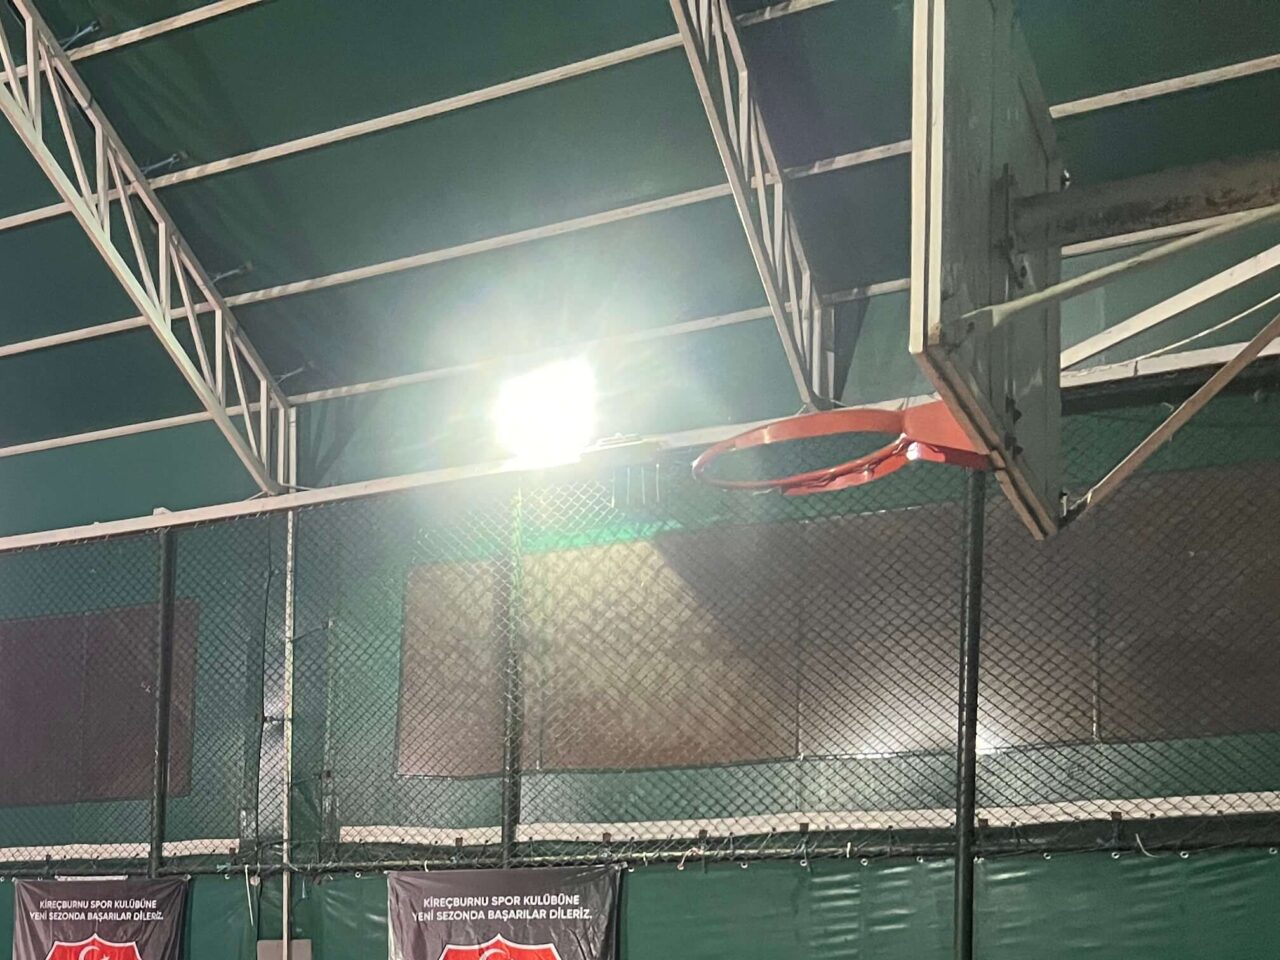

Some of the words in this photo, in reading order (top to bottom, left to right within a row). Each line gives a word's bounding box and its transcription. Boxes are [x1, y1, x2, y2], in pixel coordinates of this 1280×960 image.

[39, 898, 89, 910] KİREÇBURNU
[90, 899, 113, 909] SPOR
[114, 898, 157, 909] KULÜBÜNE
[423, 895, 489, 909] KİREÇBURNU
[491, 895, 521, 906] SPOR
[523, 893, 580, 906] KULÜBÜNE
[29, 911, 48, 921] YENİ
[48, 911, 86, 921] SEZONDA
[87, 911, 132, 923] BAŞARILAR
[411, 908, 434, 921] YENİ
[436, 909, 486, 921] SEZONDA
[487, 907, 547, 922] BAŞARILAR
